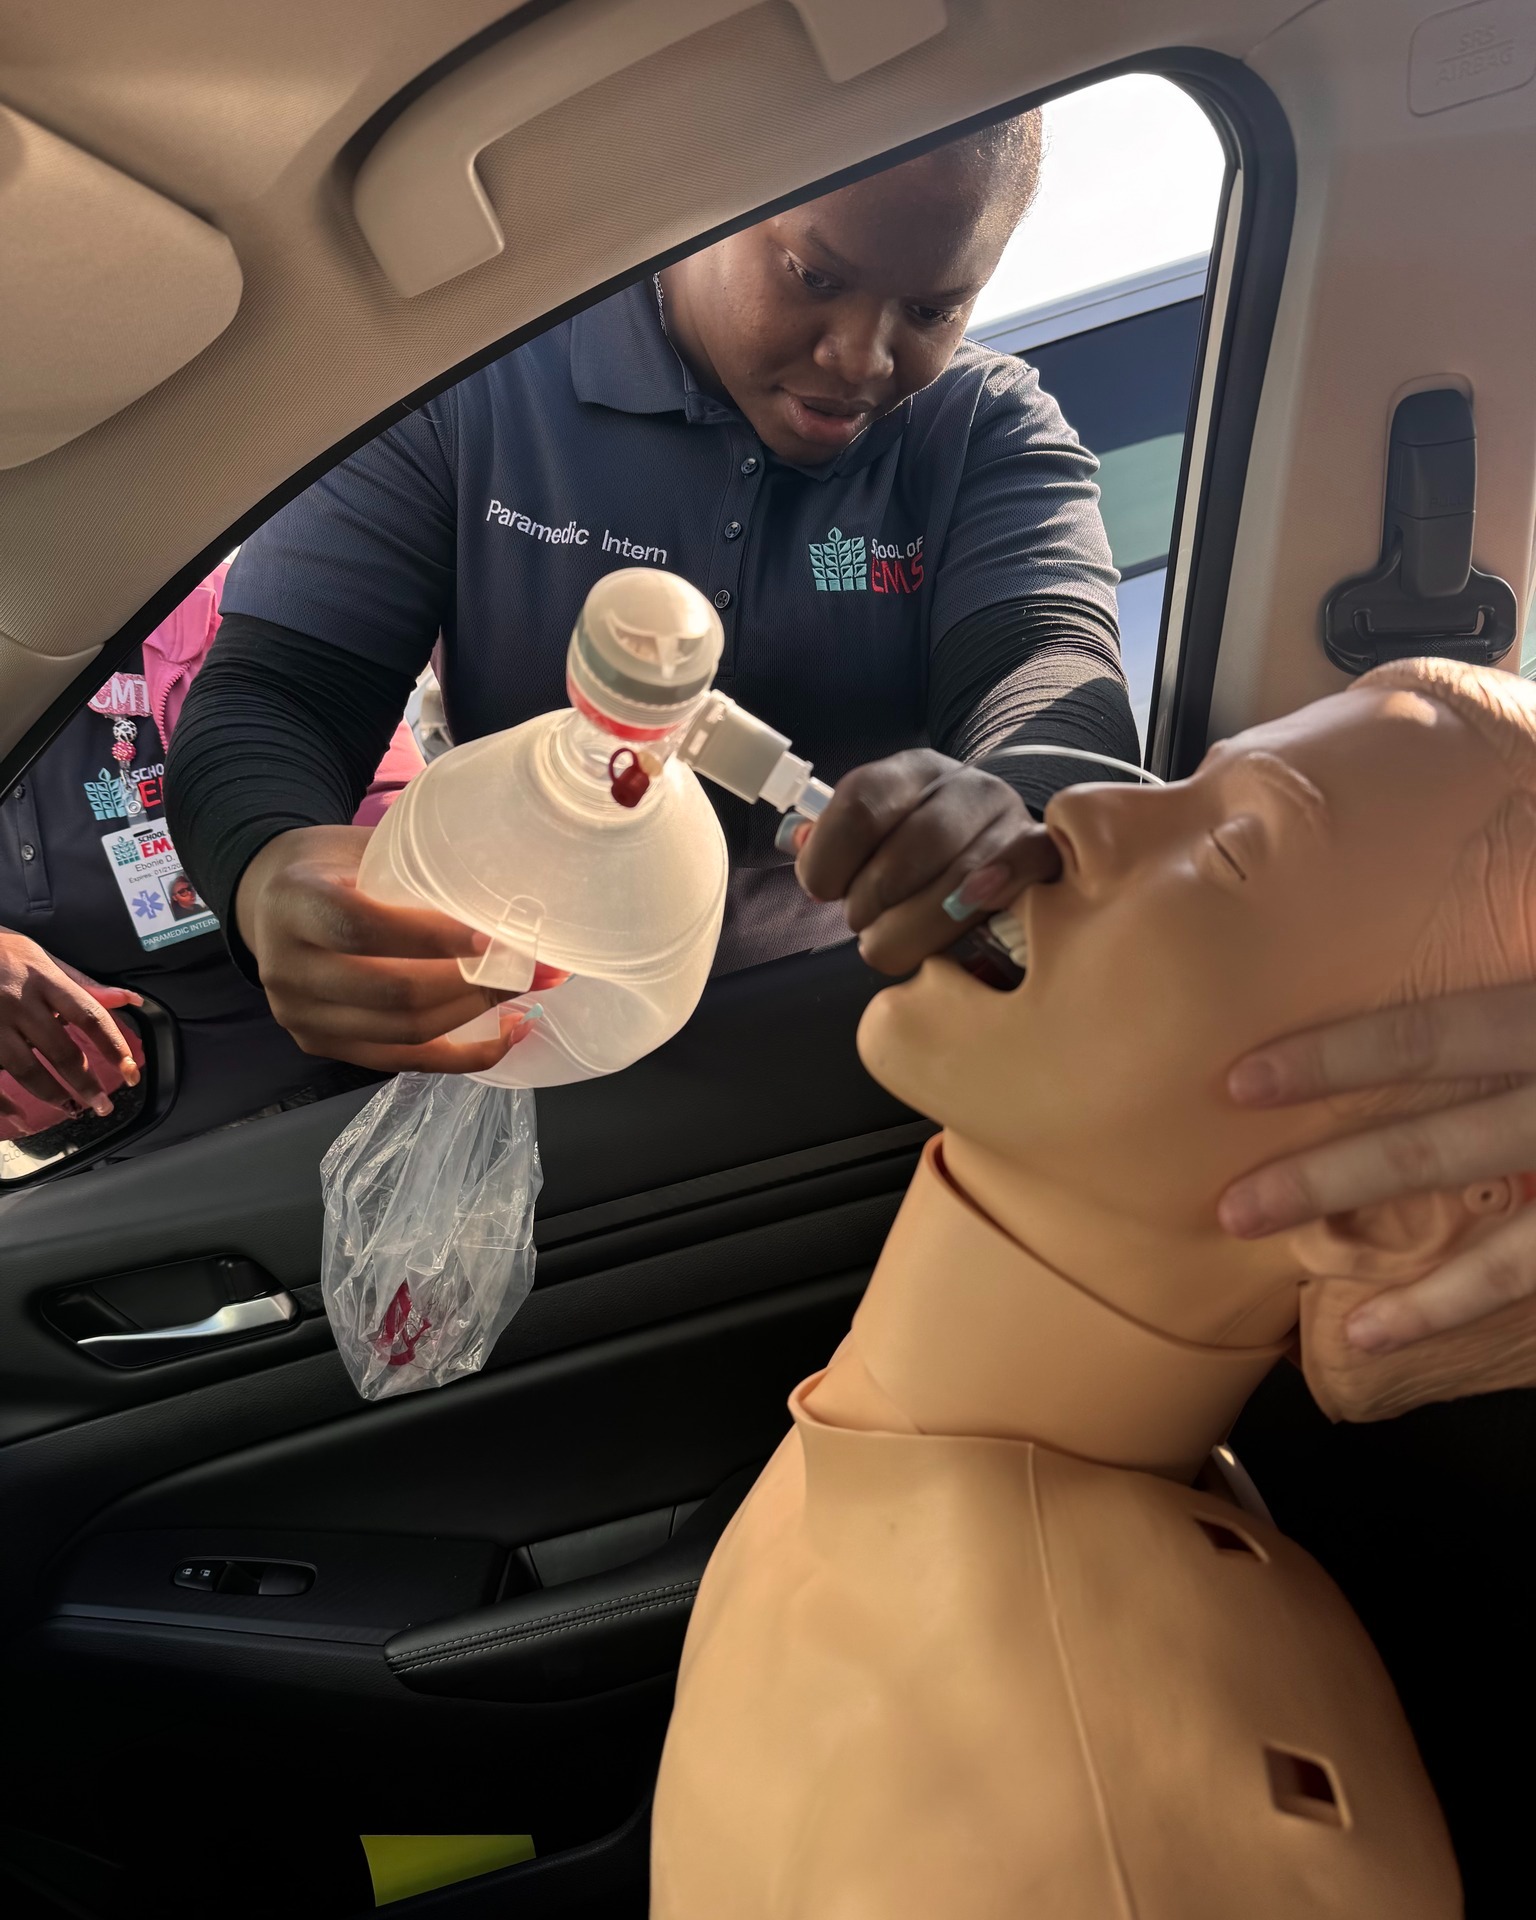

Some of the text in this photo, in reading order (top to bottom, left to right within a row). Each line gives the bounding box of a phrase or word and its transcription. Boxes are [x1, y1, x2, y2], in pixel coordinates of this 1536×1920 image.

[1435, 47, 1514, 86] AIRBAG
[486, 499, 667, 565] Paramedic Intern
[906, 535, 923, 557] OF
[871, 552, 924, 594] EMS
[131, 763, 164, 783] SCHO
[138, 777, 164, 808] E
[138, 830, 167, 843] SCHOOL
[141, 838, 175, 858] EM
[135, 854, 176, 872] Ebonie D.
[154, 863, 182, 875] 01/21/20
[143, 917, 220, 947] PARAMEDIC INTERN
